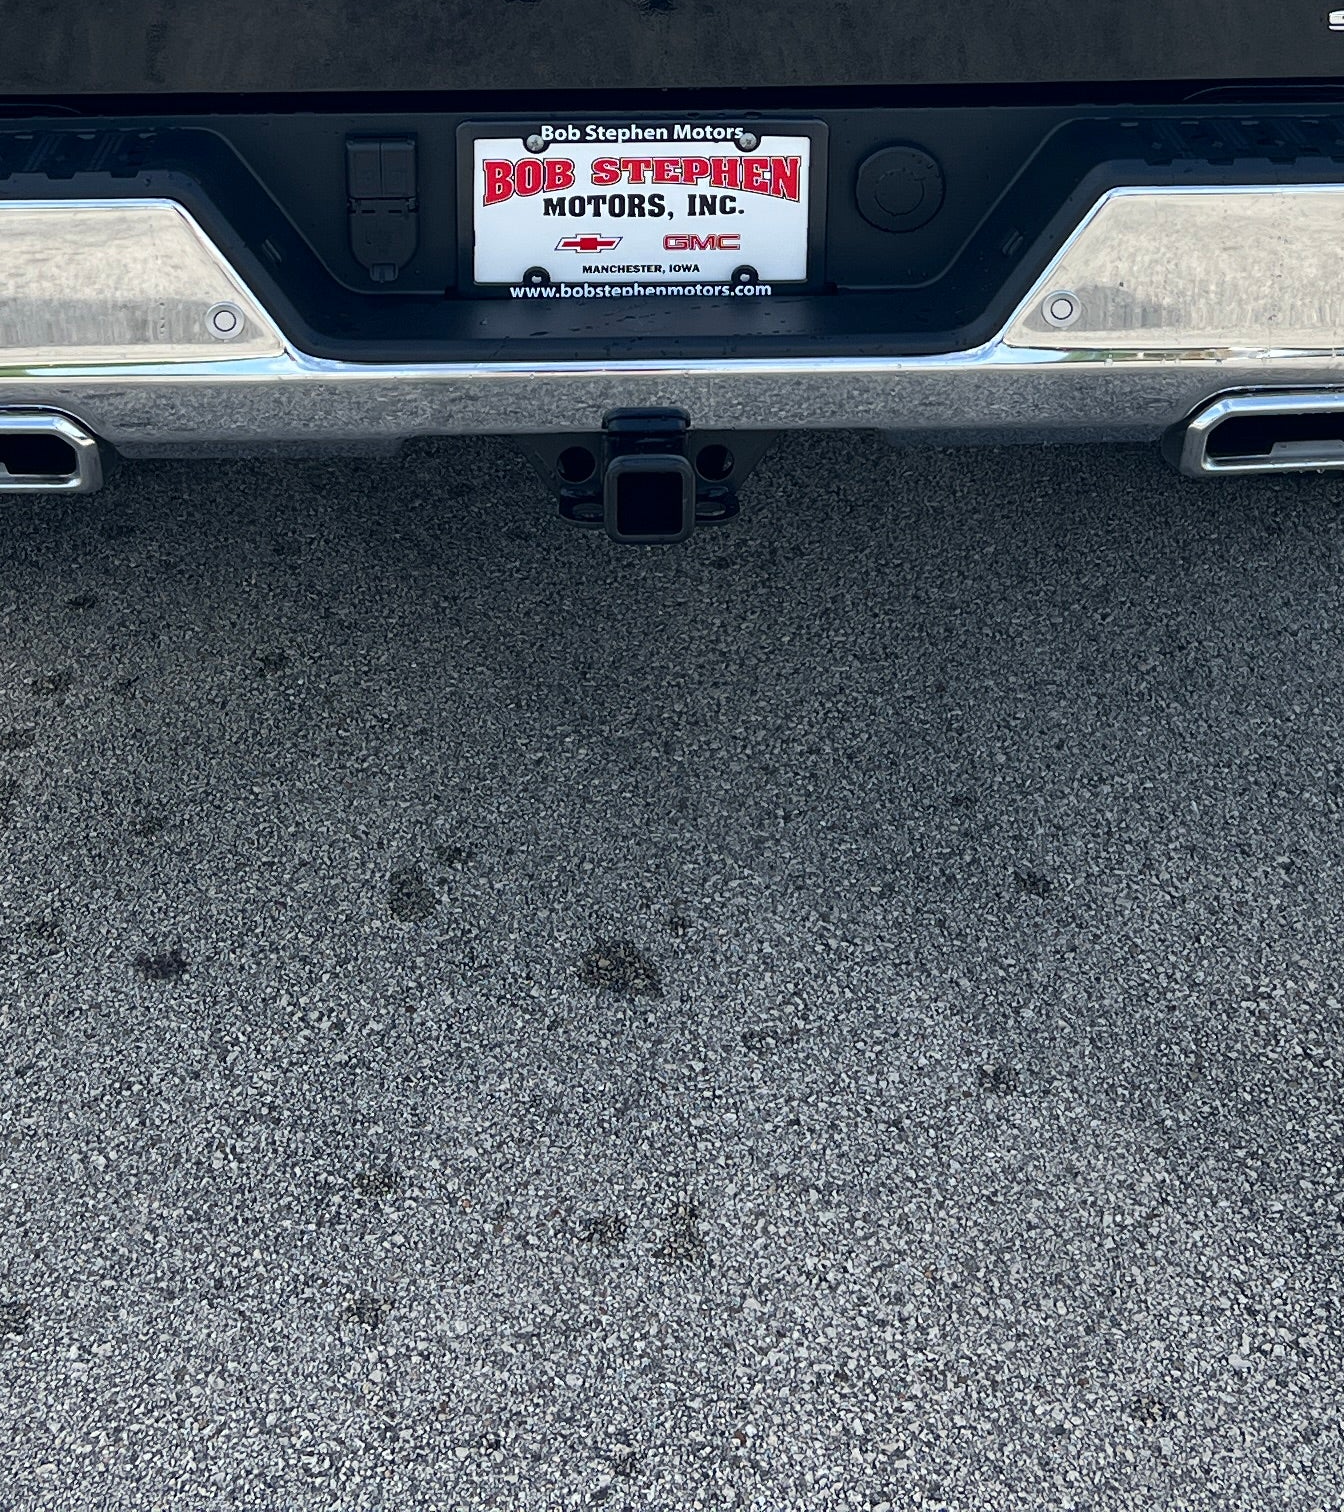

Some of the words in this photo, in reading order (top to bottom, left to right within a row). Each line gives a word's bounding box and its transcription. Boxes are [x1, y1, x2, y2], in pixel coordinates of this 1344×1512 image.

[541, 124, 581, 141] Bob
[585, 124, 671, 143] Stephen
[674, 124, 744, 140] Motors
[483, 157, 576, 206] BOB
[591, 155, 802, 203] STEPHEN
[543, 193, 675, 221] MOTORS,
[687, 193, 745, 216] INC.
[663, 233, 741, 251] GMC
[582, 264, 666, 275] MANCHESTER,
[669, 263, 700, 273] IOWA
[510, 282, 772, 298] www.bobstephenmotors.com
